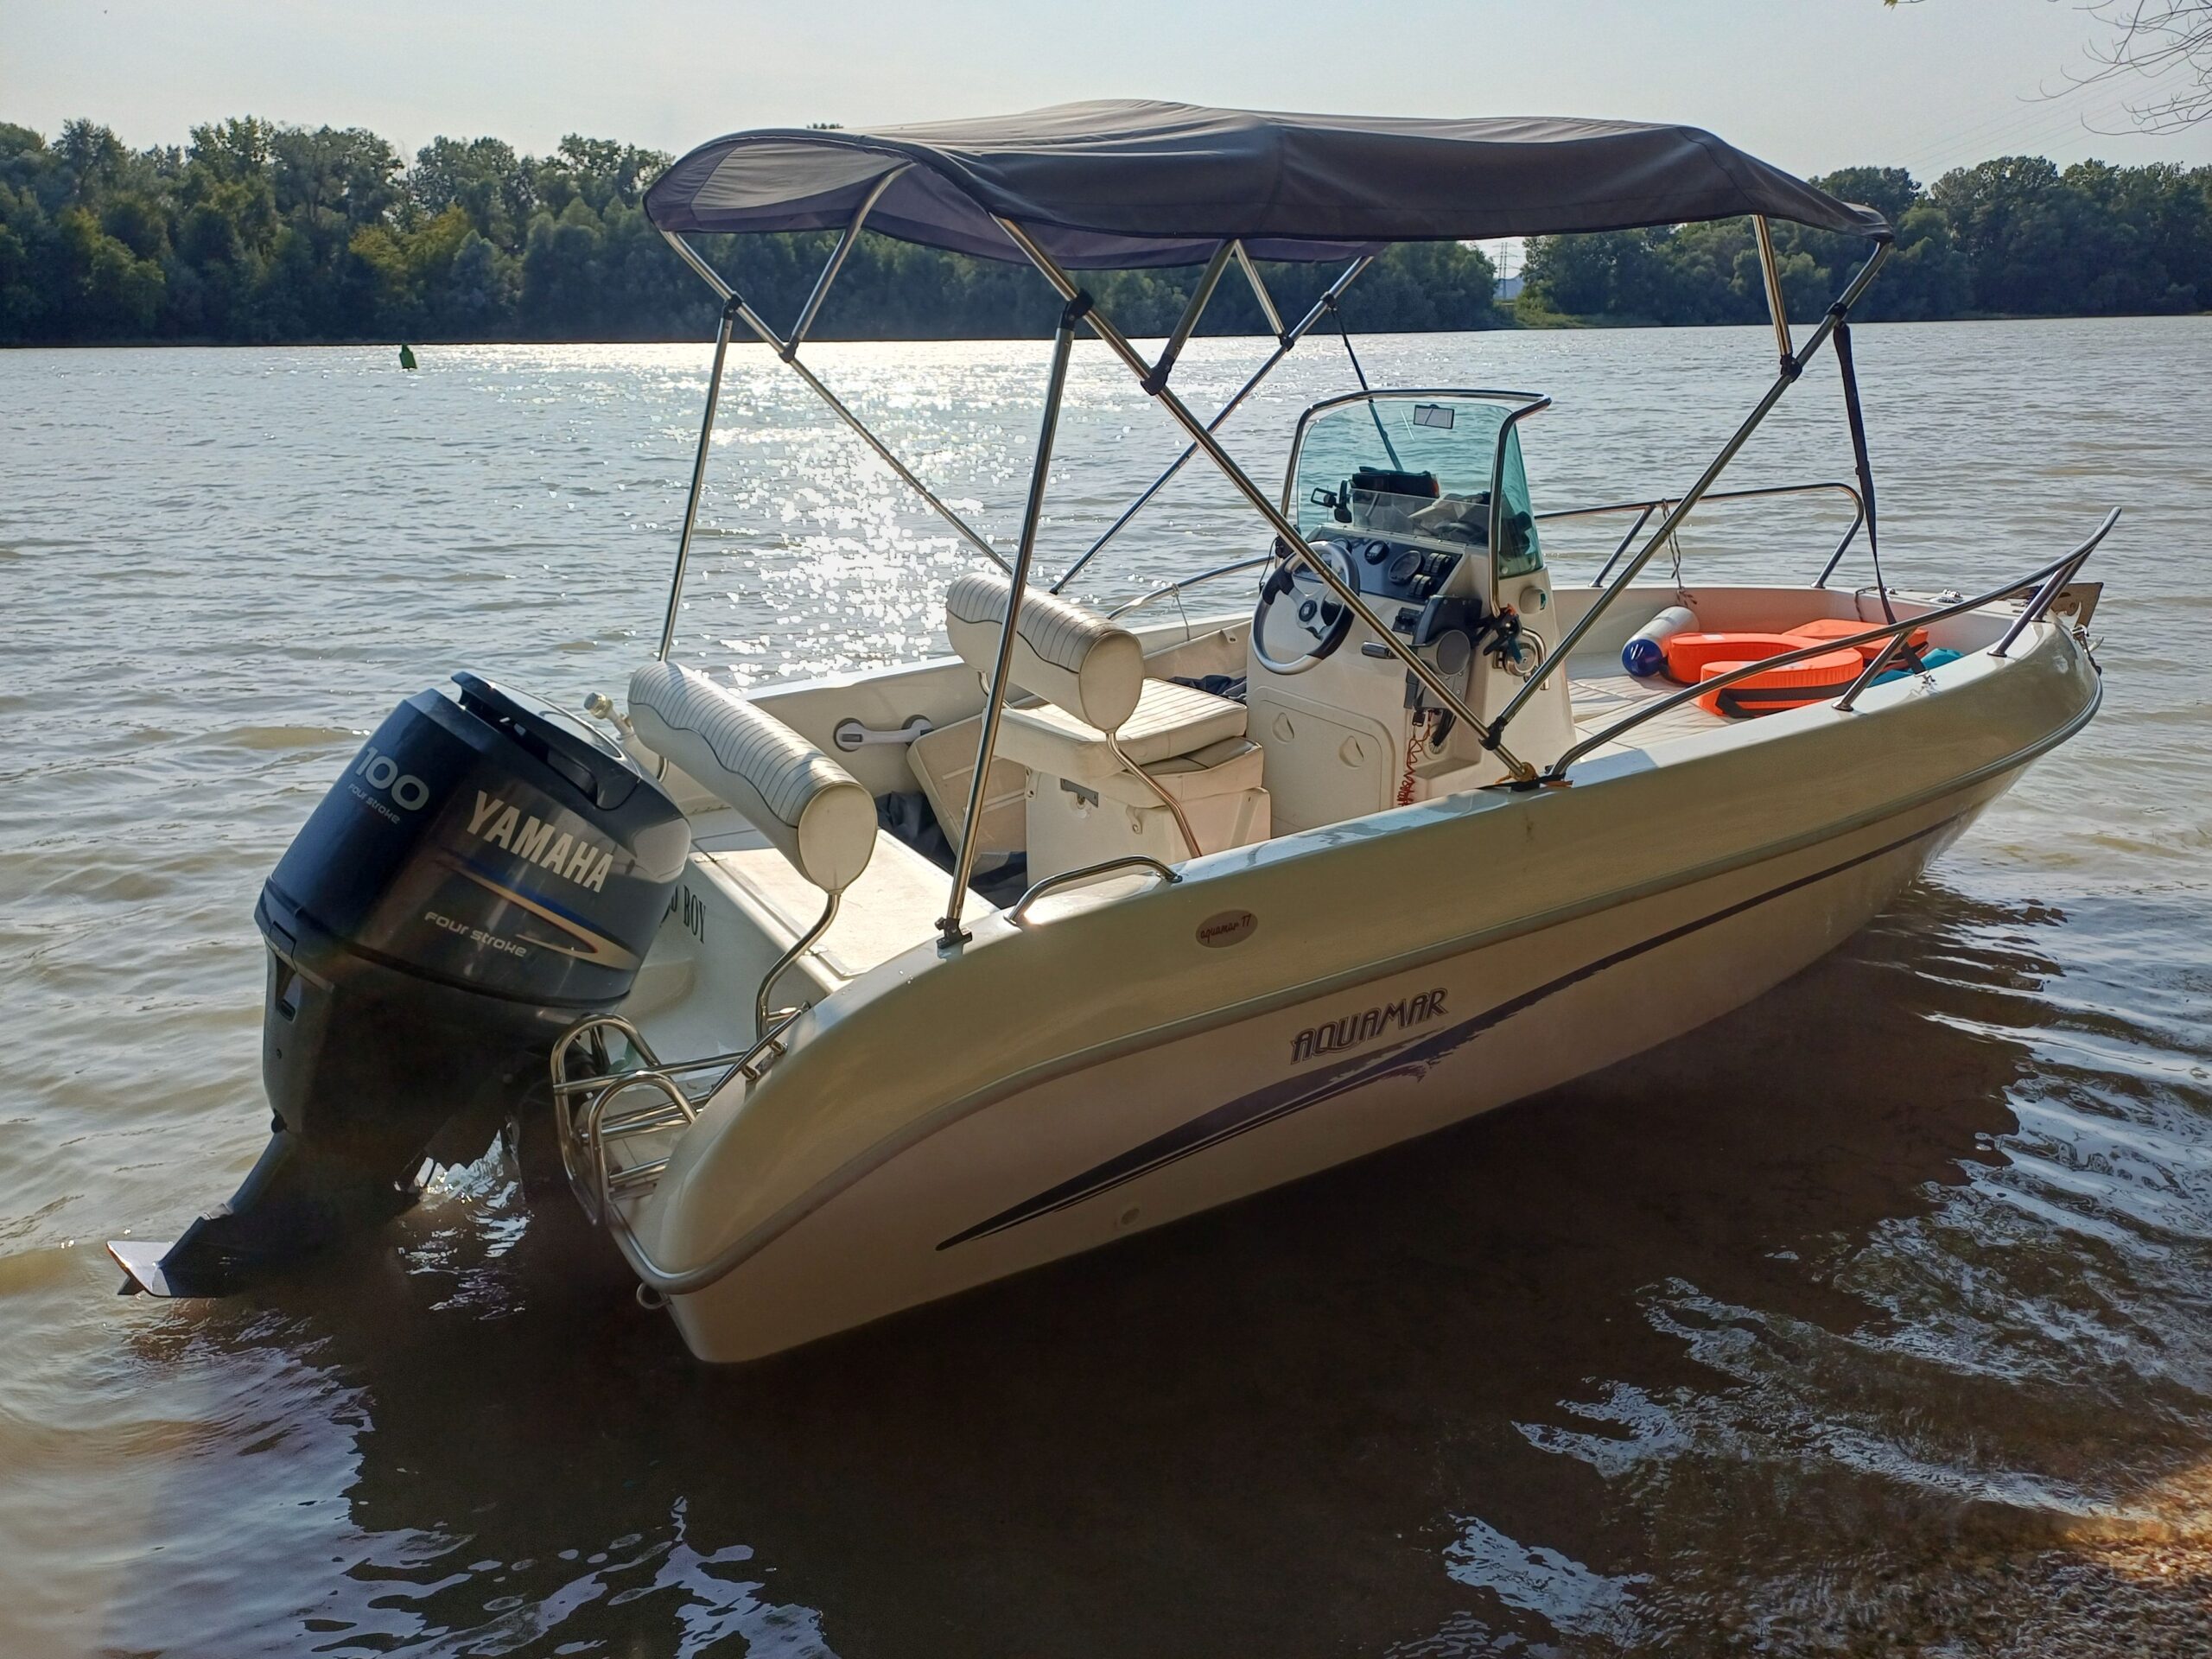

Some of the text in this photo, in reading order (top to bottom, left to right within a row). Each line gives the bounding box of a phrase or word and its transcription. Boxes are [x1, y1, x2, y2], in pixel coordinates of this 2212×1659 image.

[355, 747, 429, 810] 100
[467, 790, 614, 893] YAMAHA
[683, 884, 706, 944] BOY
[1290, 988, 1449, 1065] AQUAMAR
